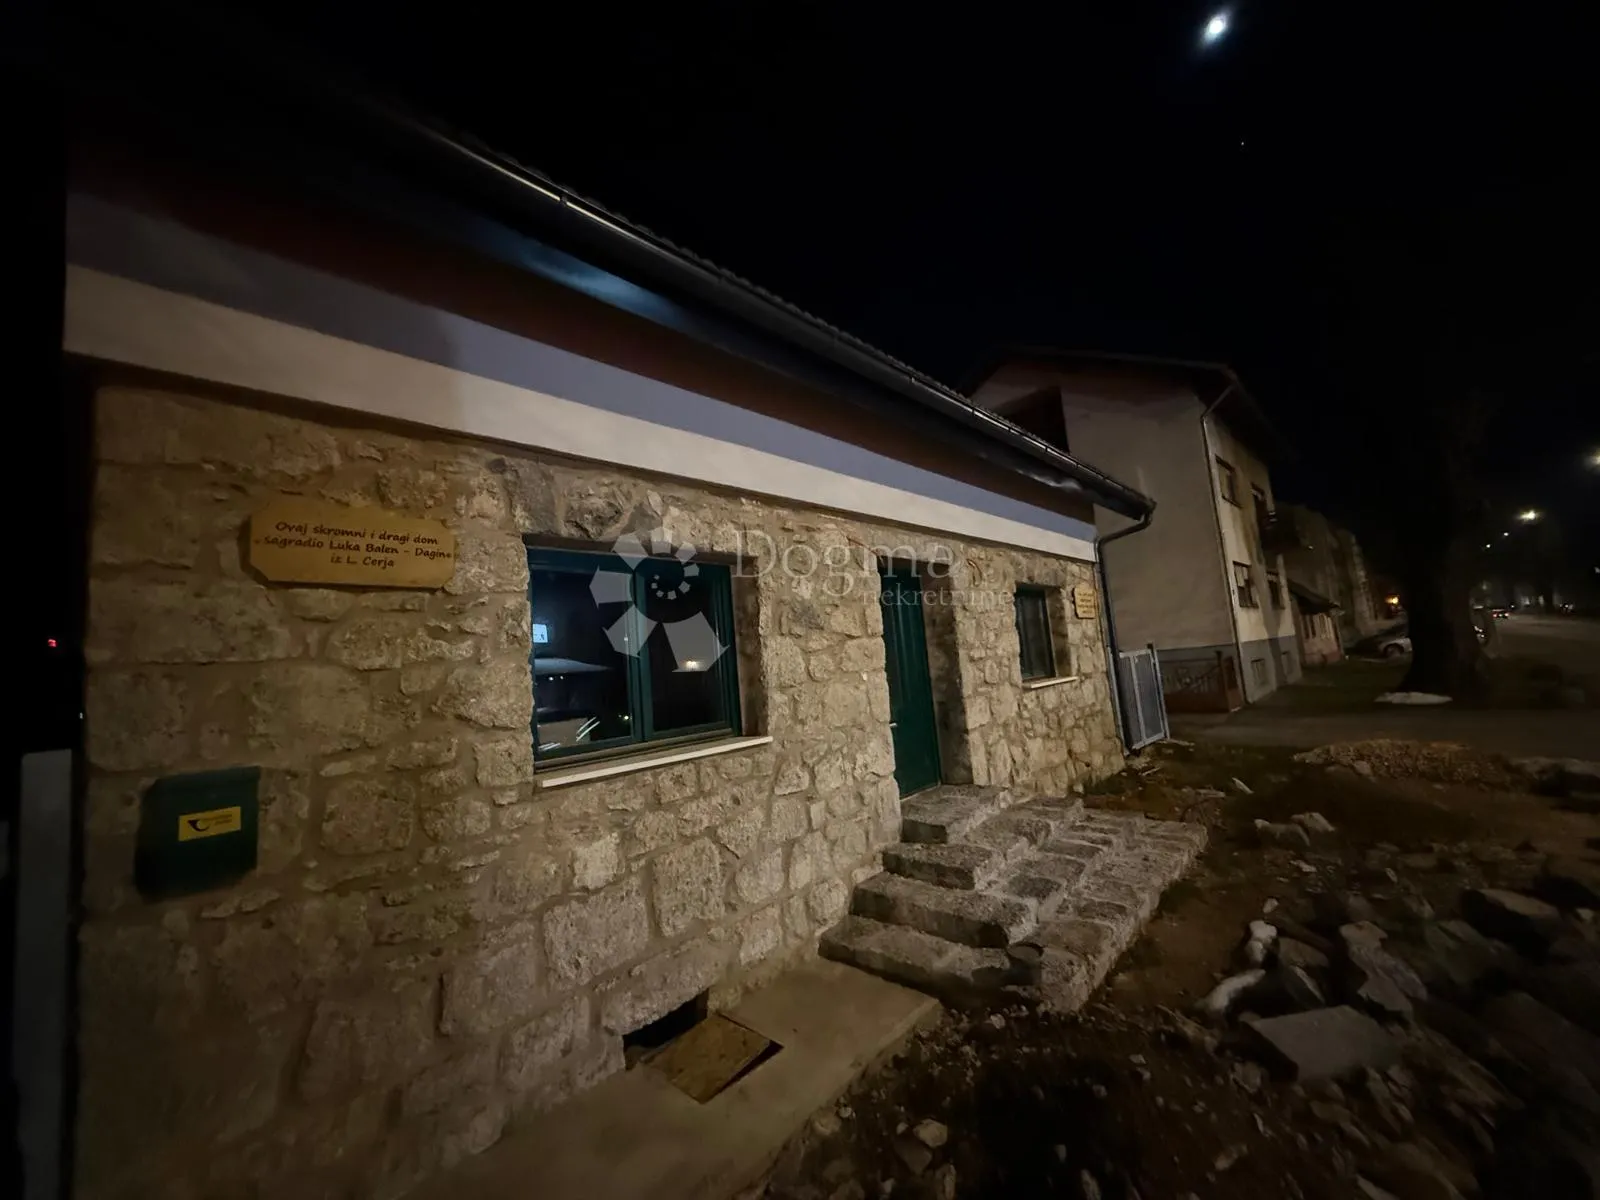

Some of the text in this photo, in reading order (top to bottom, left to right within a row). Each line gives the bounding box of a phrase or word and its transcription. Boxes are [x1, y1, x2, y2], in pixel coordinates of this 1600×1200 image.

[275, 521, 308, 536] Ovaj
[313, 524, 367, 538] skromni
[379, 529, 410, 545] dragi
[413, 534, 438, 545] dom
[330, 540, 360, 551] Luka
[366, 543, 399, 554] Balen
[362, 556, 394, 571] Cerja
